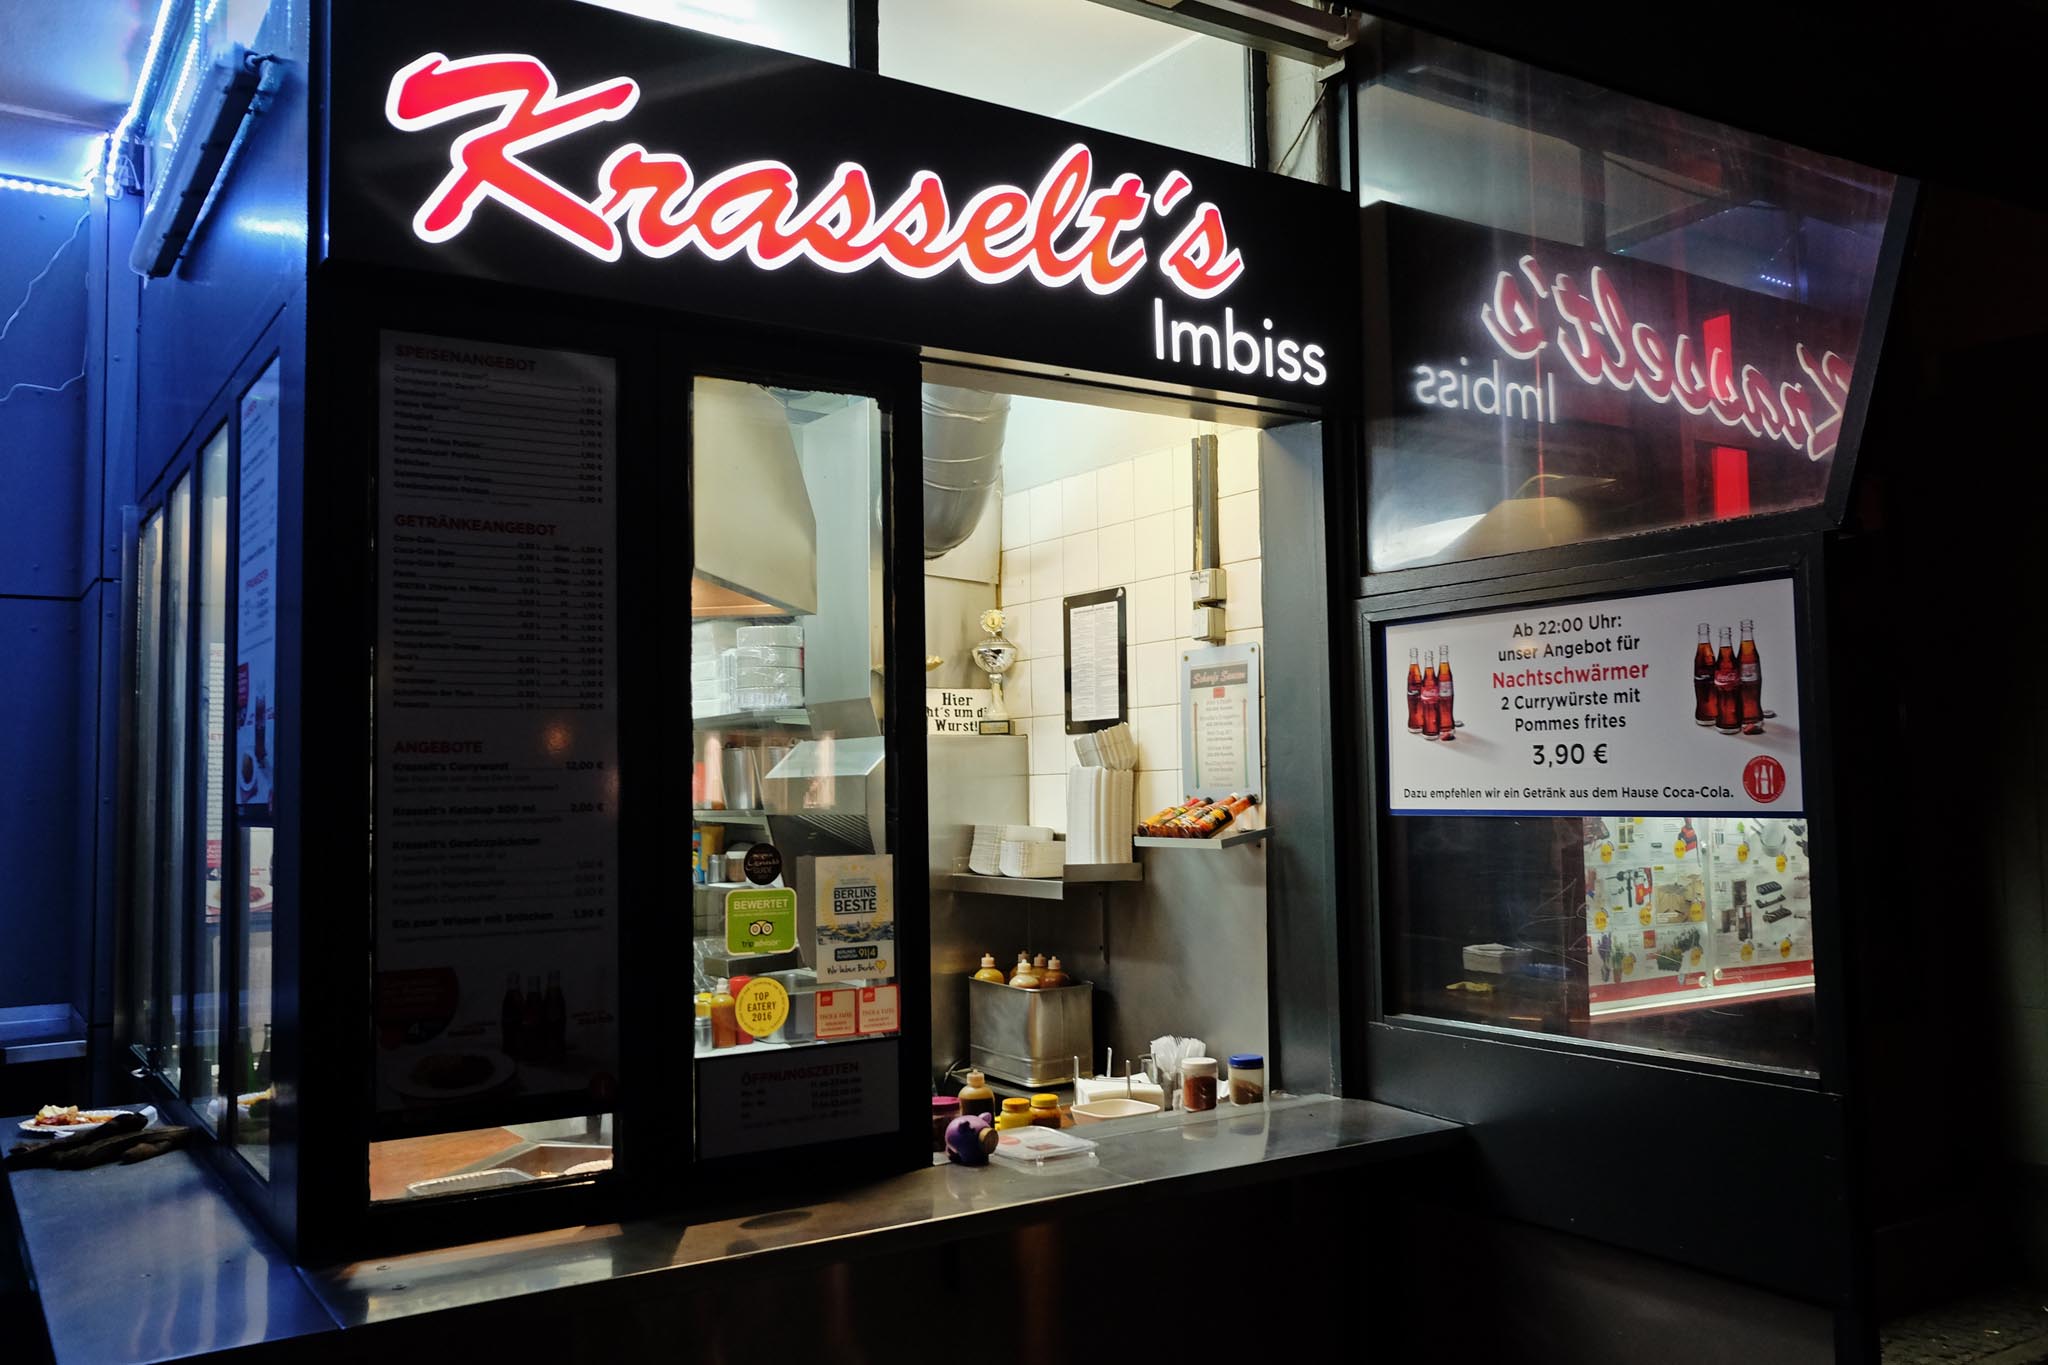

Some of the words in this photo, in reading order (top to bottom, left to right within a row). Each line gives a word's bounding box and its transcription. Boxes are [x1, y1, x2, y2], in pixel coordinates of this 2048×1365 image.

[386, 52, 1244, 298] Krasselt's
[1154, 298, 1327, 387] Imbiss
[395, 343, 536, 372] SPEISENANGEBOT
[394, 513, 558, 536] GETRÄNKEANGEBOT
[1512, 623, 1534, 639] Ab
[1538, 617, 1584, 636] 22:00
[1589, 613, 1623, 631] Uhr:
[1498, 647, 1538, 662] unser
[1543, 638, 1612, 661] Angebot
[1616, 635, 1641, 652] für
[1492, 661, 1650, 690] Nachtschwärmer
[941, 692, 974, 706] Hier
[1500, 696, 1510, 711] 2
[1514, 691, 1609, 713] Currywürste
[1613, 687, 1641, 704] mit
[926, 706, 950, 718] ht's
[953, 708, 974, 718] um
[935, 719, 979, 732] Wurst!
[1515, 717, 1582, 733] Pommes
[1584, 712, 1627, 729] frites
[393, 740, 483, 753] ANGEBOTE
[1532, 743, 1585, 767] 3,90
[1593, 742, 1608, 764] €
[1404, 788, 1428, 799] Dazu
[1429, 787, 1482, 800] empfehlen
[1484, 787, 1501, 798] wir
[1503, 787, 1520, 798] ein
[1522, 786, 1567, 798] Getränk
[1568, 788, 1589, 799] aus
[1592, 786, 1618, 798] dem
[1622, 786, 1659, 798] Hause
[1662, 785, 1735, 799] Coca-Cola.
[834, 887, 877, 899] BERLINS
[733, 898, 789, 910] BEWERTET
[834, 898, 877, 912] BESTE
[754, 991, 769, 1001] TOP
[747, 1001, 777, 1012] EATERY
[752, 1012, 772, 1022] 2016
[741, 1060, 859, 1086] ÖFFNUNGSZEITEN
